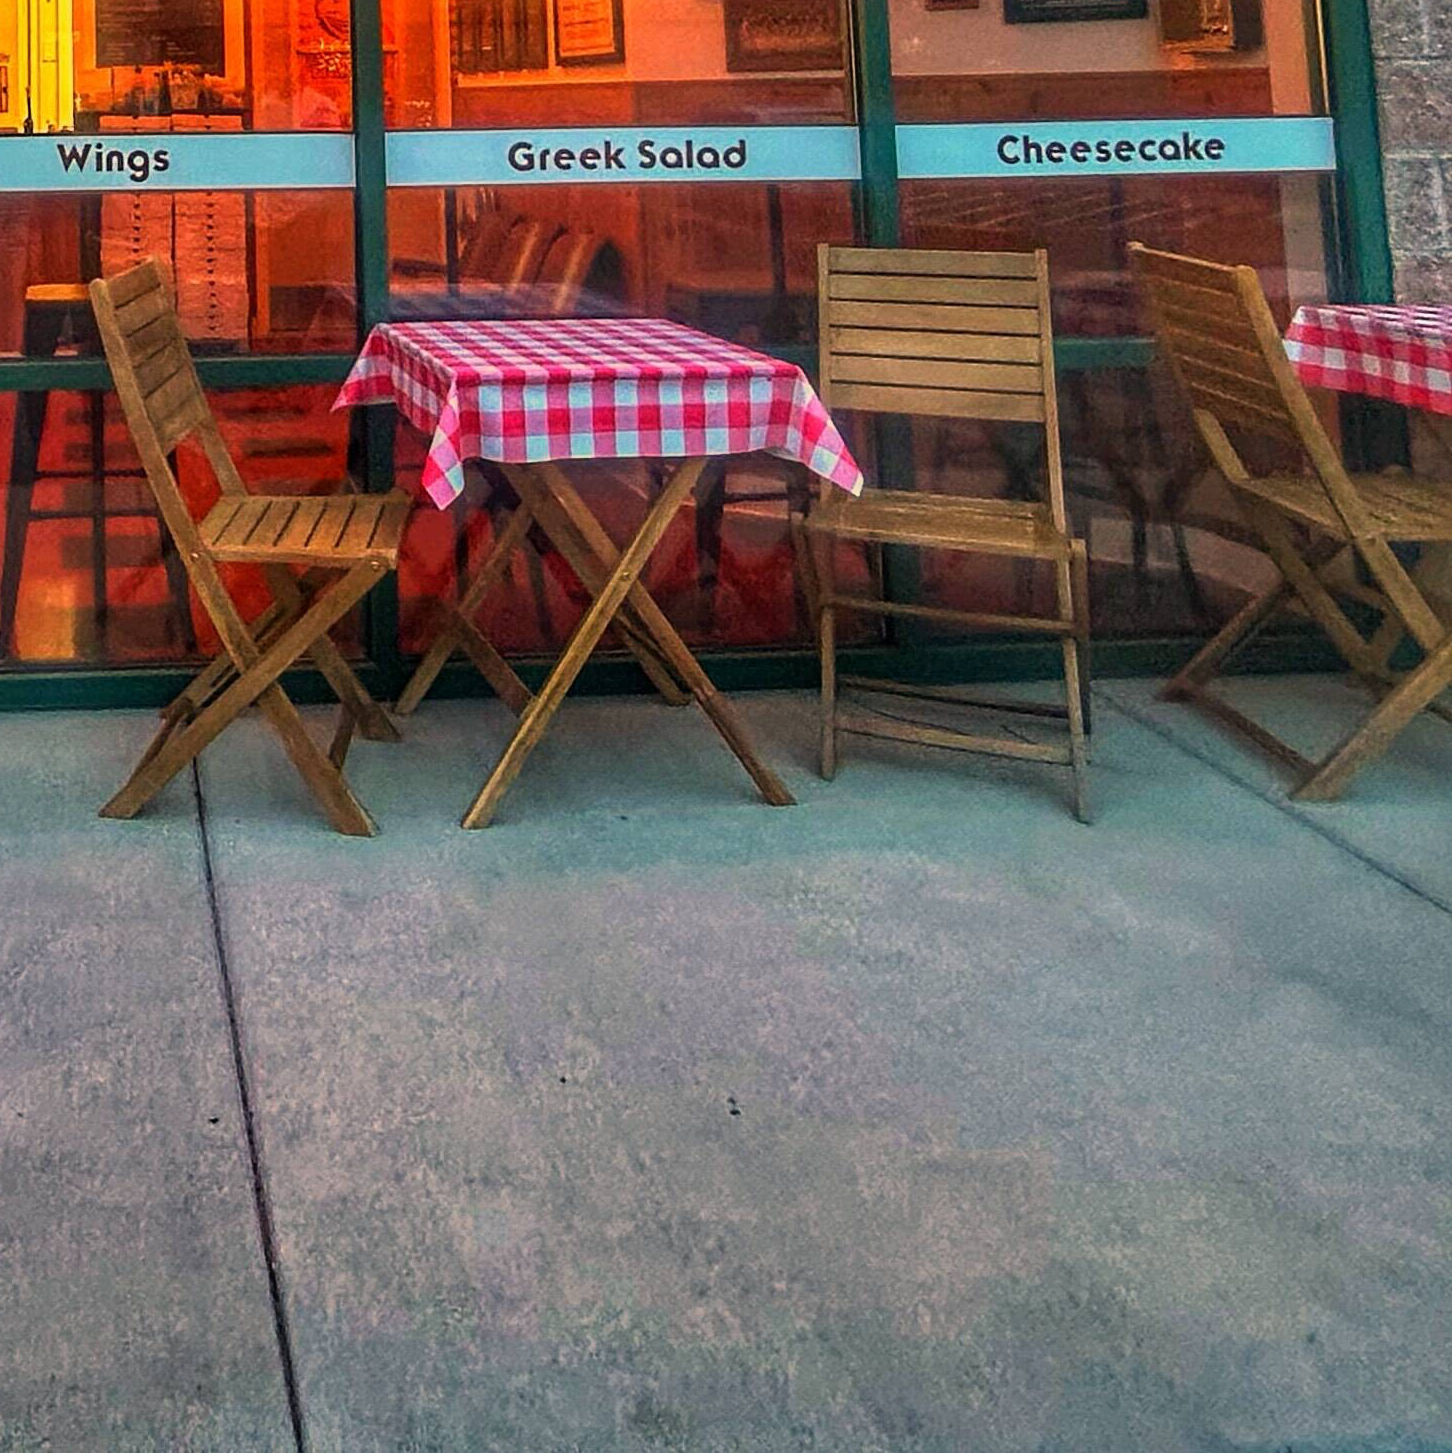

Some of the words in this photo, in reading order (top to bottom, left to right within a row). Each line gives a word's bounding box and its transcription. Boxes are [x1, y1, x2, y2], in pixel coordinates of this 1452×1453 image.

[56, 142, 170, 183] Wings
[507, 140, 627, 171] Greek
[637, 139, 747, 169] Salad
[997, 131, 1226, 165] Cheesecake
